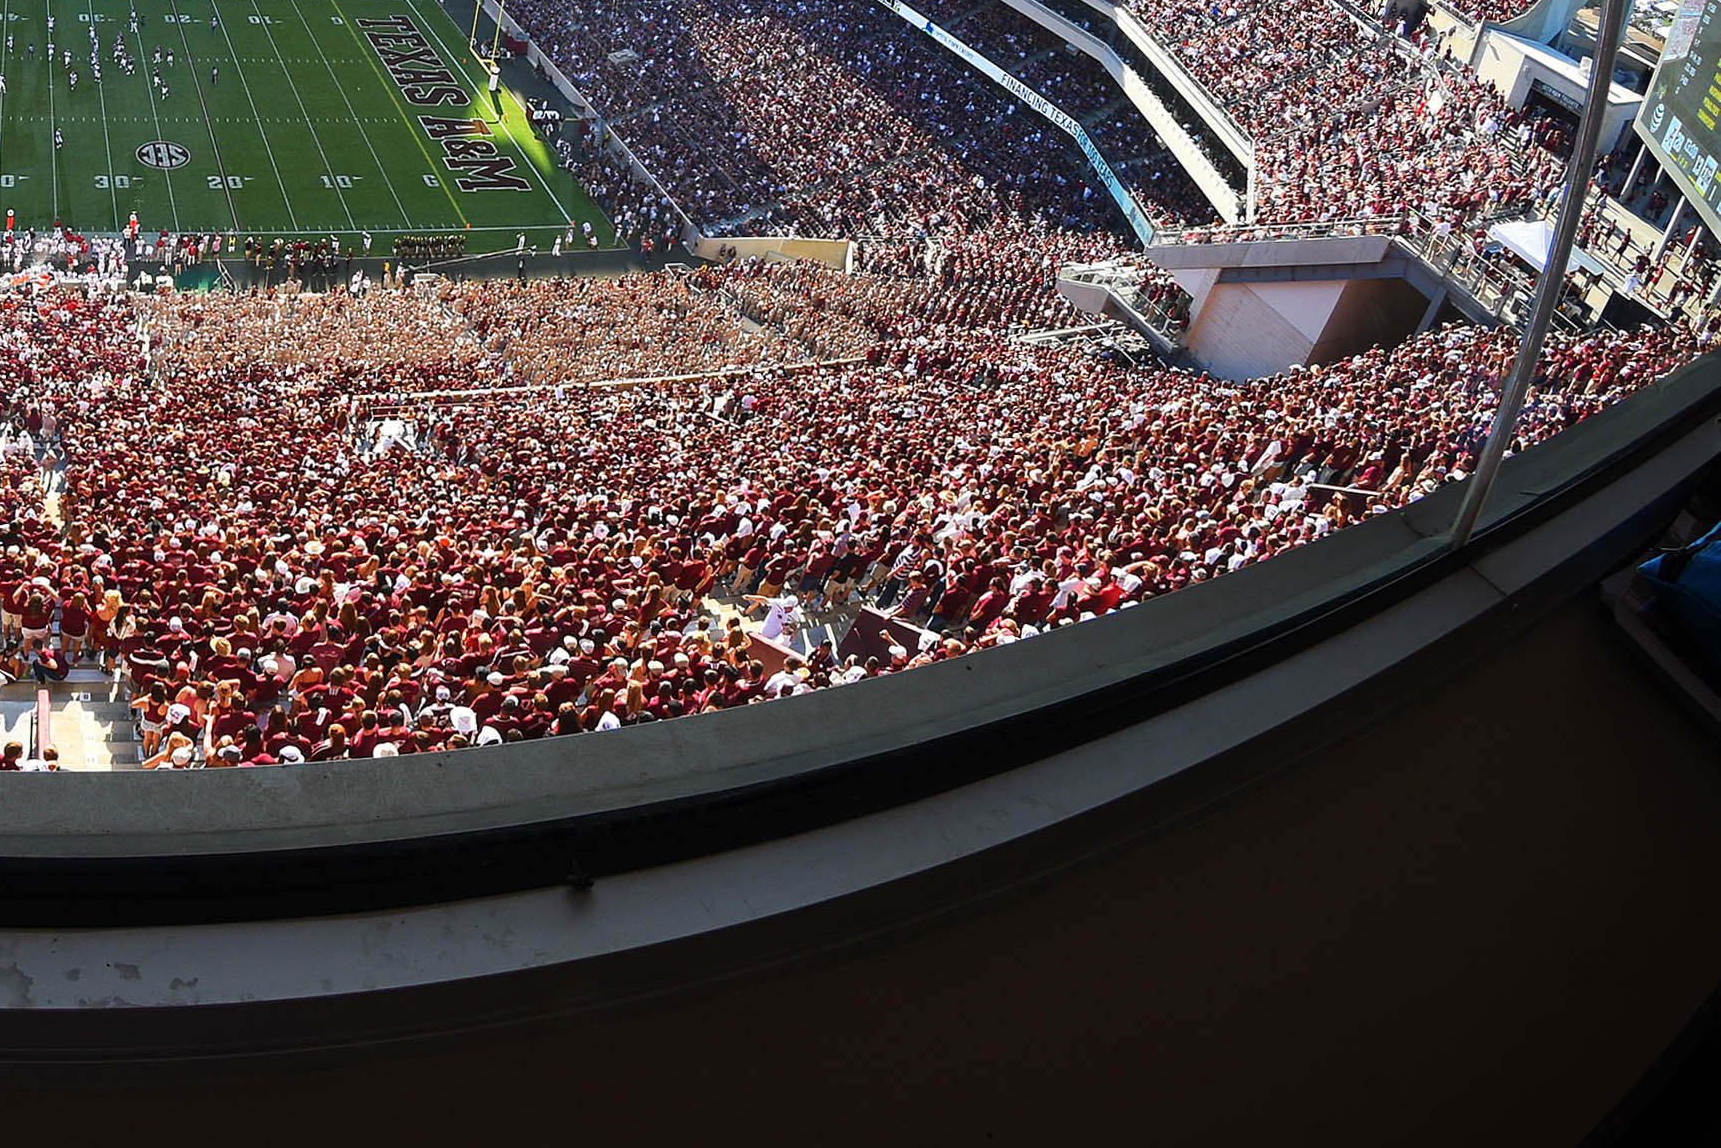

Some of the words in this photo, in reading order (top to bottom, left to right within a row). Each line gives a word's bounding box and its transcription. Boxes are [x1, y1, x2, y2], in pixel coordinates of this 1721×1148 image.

[356, 14, 471, 107] TEXAS
[417, 115, 532, 192] A&M
[1000, 73, 1049, 114] FINANCING
[1050, 107, 1080, 137] TEXAS
[140, 143, 187, 167] SEC
[93, 174, 130, 189] 30
[207, 175, 243, 189] 20
[320, 175, 353, 189] 10
